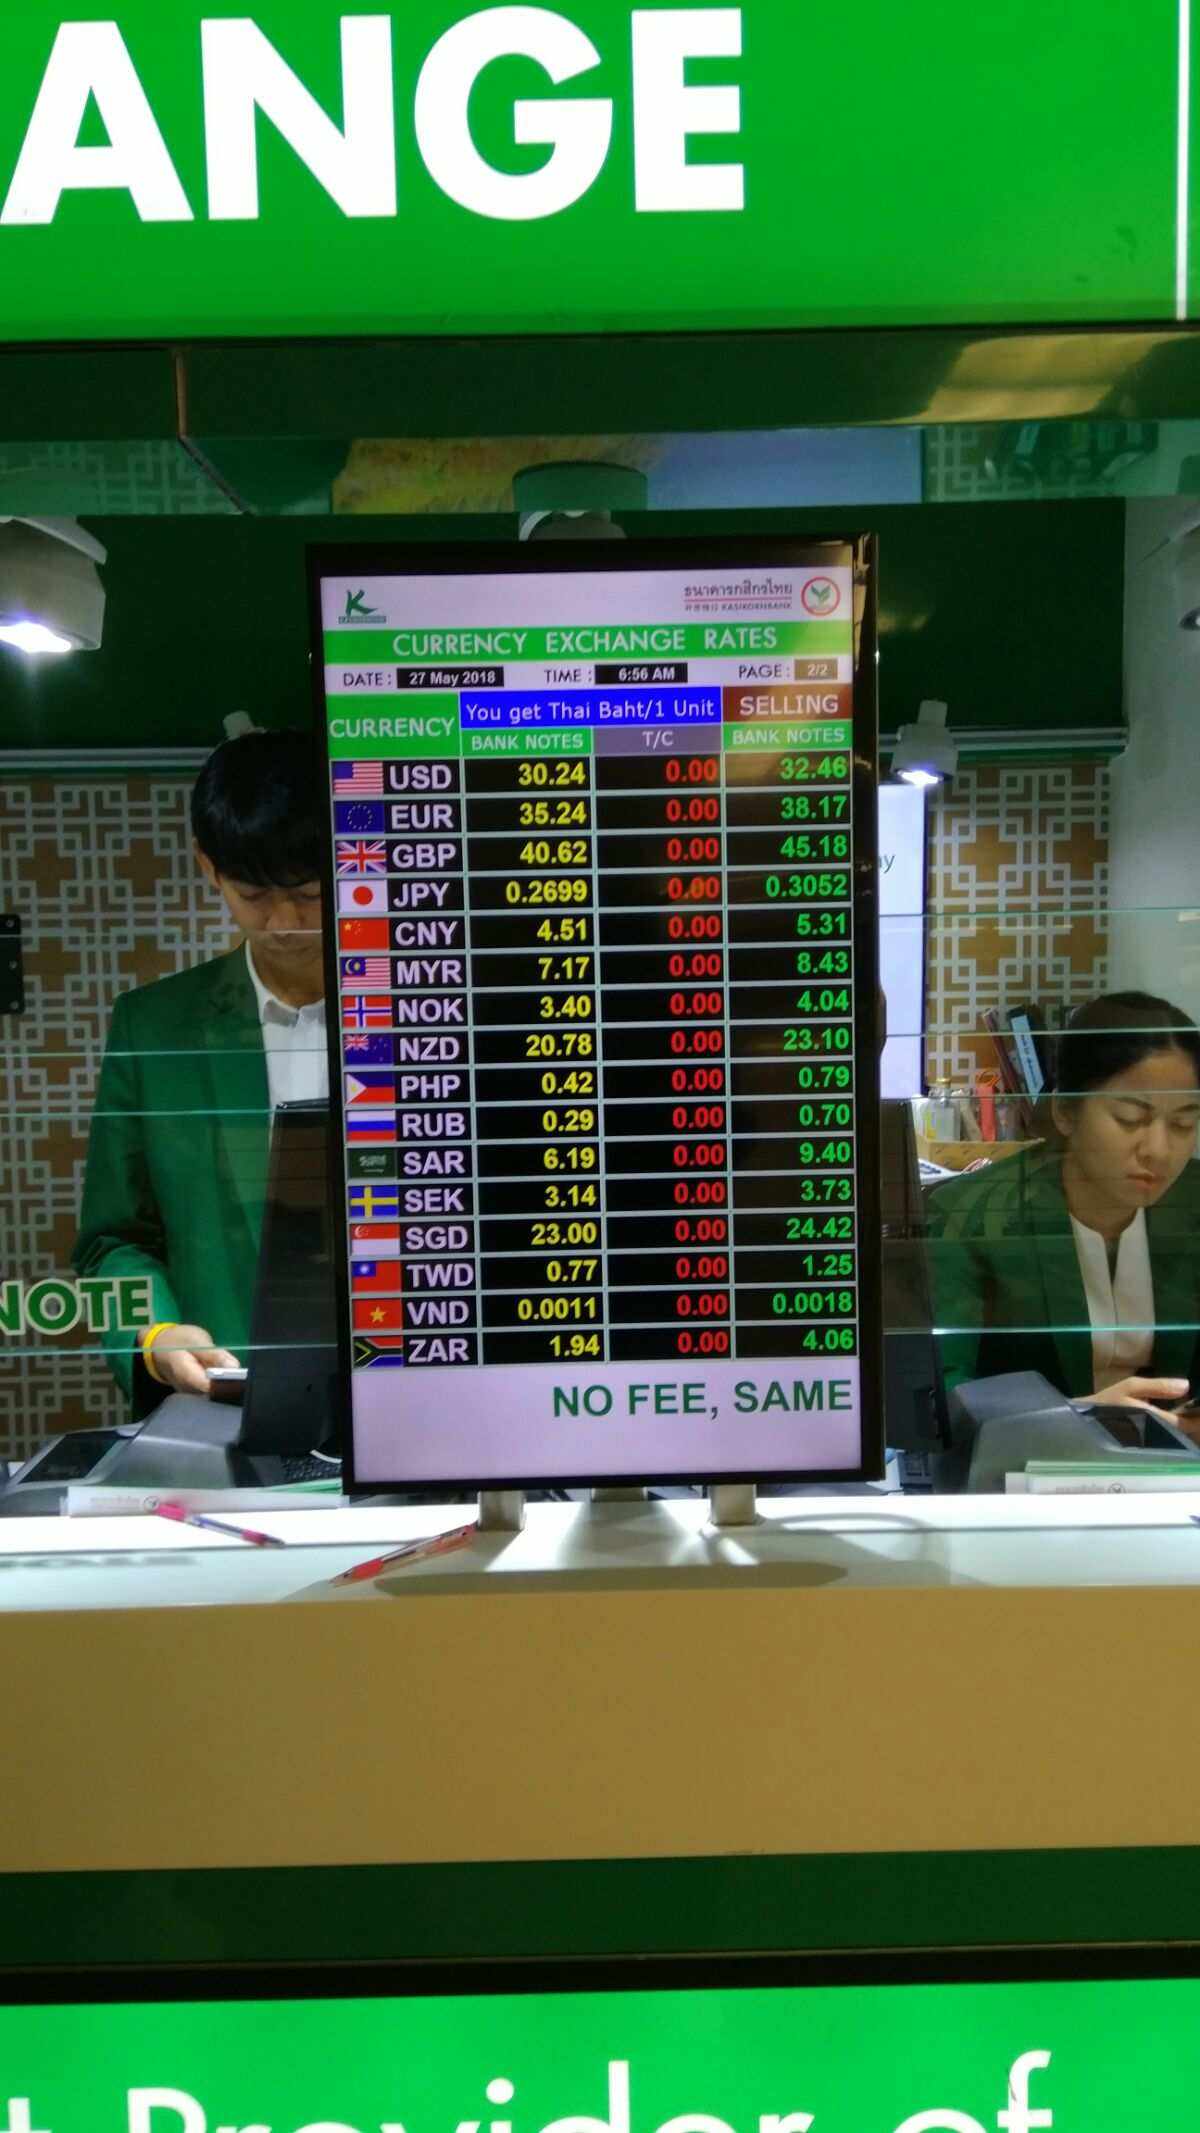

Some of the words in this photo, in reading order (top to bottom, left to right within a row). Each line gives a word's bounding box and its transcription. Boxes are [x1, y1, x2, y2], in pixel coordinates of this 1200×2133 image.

[0, 5, 746, 224] ANGE
[392, 632, 527, 657] CURRENCY
[546, 629, 686, 653] EXCHANGE
[704, 626, 777, 650] RATES
[409, 672, 426, 686] 27
[430, 671, 459, 688] May
[462, 670, 497, 684] 2018
[618, 667, 649, 682] 6:56
[652, 667, 676, 681] AM
[806, 664, 829, 678] 2/2
[466, 703, 502, 723] You
[509, 705, 542, 725] get
[548, 701, 591, 720] Thai
[599, 699, 665, 720] Baht/1
[674, 698, 715, 717] Unit
[739, 693, 839, 717] SELLING
[329, 716, 455, 739] CURRENCY
[732, 729, 780, 746] BANK
[786, 726, 845, 744] NOTES
[471, 735, 519, 751] BANK
[525, 732, 584, 750] NOTES
[642, 730, 675, 750] T/C
[389, 764, 452, 790] USD
[518, 762, 586, 786] 30.24
[665, 757, 720, 783] 0.00
[782, 755, 848, 780] 32.46
[391, 804, 454, 829] EUR
[519, 801, 587, 825] 35.24
[666, 798, 719, 822] 0.00
[781, 795, 847, 819] 38.17
[392, 843, 456, 868] GBP
[519, 840, 587, 864] 40.62
[666, 837, 719, 861] 0.00
[780, 834, 848, 858] 45.18
[392, 881, 451, 908] JPY
[506, 879, 588, 903] 0.2699
[666, 876, 721, 900] 0.00
[765, 873, 847, 897] 0.3052
[394, 919, 459, 946] CNY
[536, 918, 586, 941] 4.51
[668, 914, 721, 938] 0.00
[797, 912, 846, 935] 5.31
[396, 958, 463, 985] MYR
[538, 956, 590, 980] 7.17
[668, 954, 721, 976] 0.00
[797, 951, 849, 973] 8.43
[397, 997, 464, 1025] NOK
[540, 995, 592, 1018] 3.40
[669, 992, 722, 1014] 0.00
[797, 989, 849, 1011] 4.04
[399, 1036, 461, 1062] NZD
[526, 1033, 592, 1057] 20.78
[670, 1030, 723, 1052] 0.00
[783, 1027, 850, 1049] 23.10
[400, 1073, 461, 1100] PHP
[541, 1071, 593, 1094] 0.42
[671, 1068, 724, 1090] 0.00
[798, 1065, 850, 1087] 0.79
[401, 1111, 466, 1138] RUB
[542, 1109, 594, 1132] 0.29
[672, 1106, 724, 1128] 0.00
[799, 1103, 851, 1125] 0.70
[402, 1149, 466, 1176] SAR
[543, 1147, 595, 1169] 6.19
[673, 1143, 724, 1166] 0.00
[799, 1141, 851, 1163] 9.40
[404, 1187, 465, 1214] SEK
[545, 1184, 597, 1207] 3.14
[673, 1181, 726, 1204] 0.00
[801, 1179, 852, 1201] 3.73
[405, 1225, 469, 1251] SGD
[532, 1222, 597, 1245] 23.00
[674, 1219, 726, 1242] 0.00
[786, 1216, 852, 1239] 24.42
[406, 1262, 475, 1289] TWD
[546, 1259, 598, 1282] 0.77
[676, 1256, 727, 1279] 0.00
[803, 1253, 853, 1276] 1.25
[407, 1300, 469, 1325] VND
[518, 1297, 595, 1320] 0.0011
[676, 1294, 728, 1316] 0.00
[772, 1291, 853, 1314] 0.0018
[408, 1338, 469, 1363] ZAR
[550, 1334, 600, 1356] 1.94
[677, 1331, 729, 1353] 0.00
[803, 1328, 854, 1350] 4.06
[553, 1385, 613, 1417] NO
[628, 1383, 718, 1419] FEE,
[734, 1379, 853, 1413] SAME
